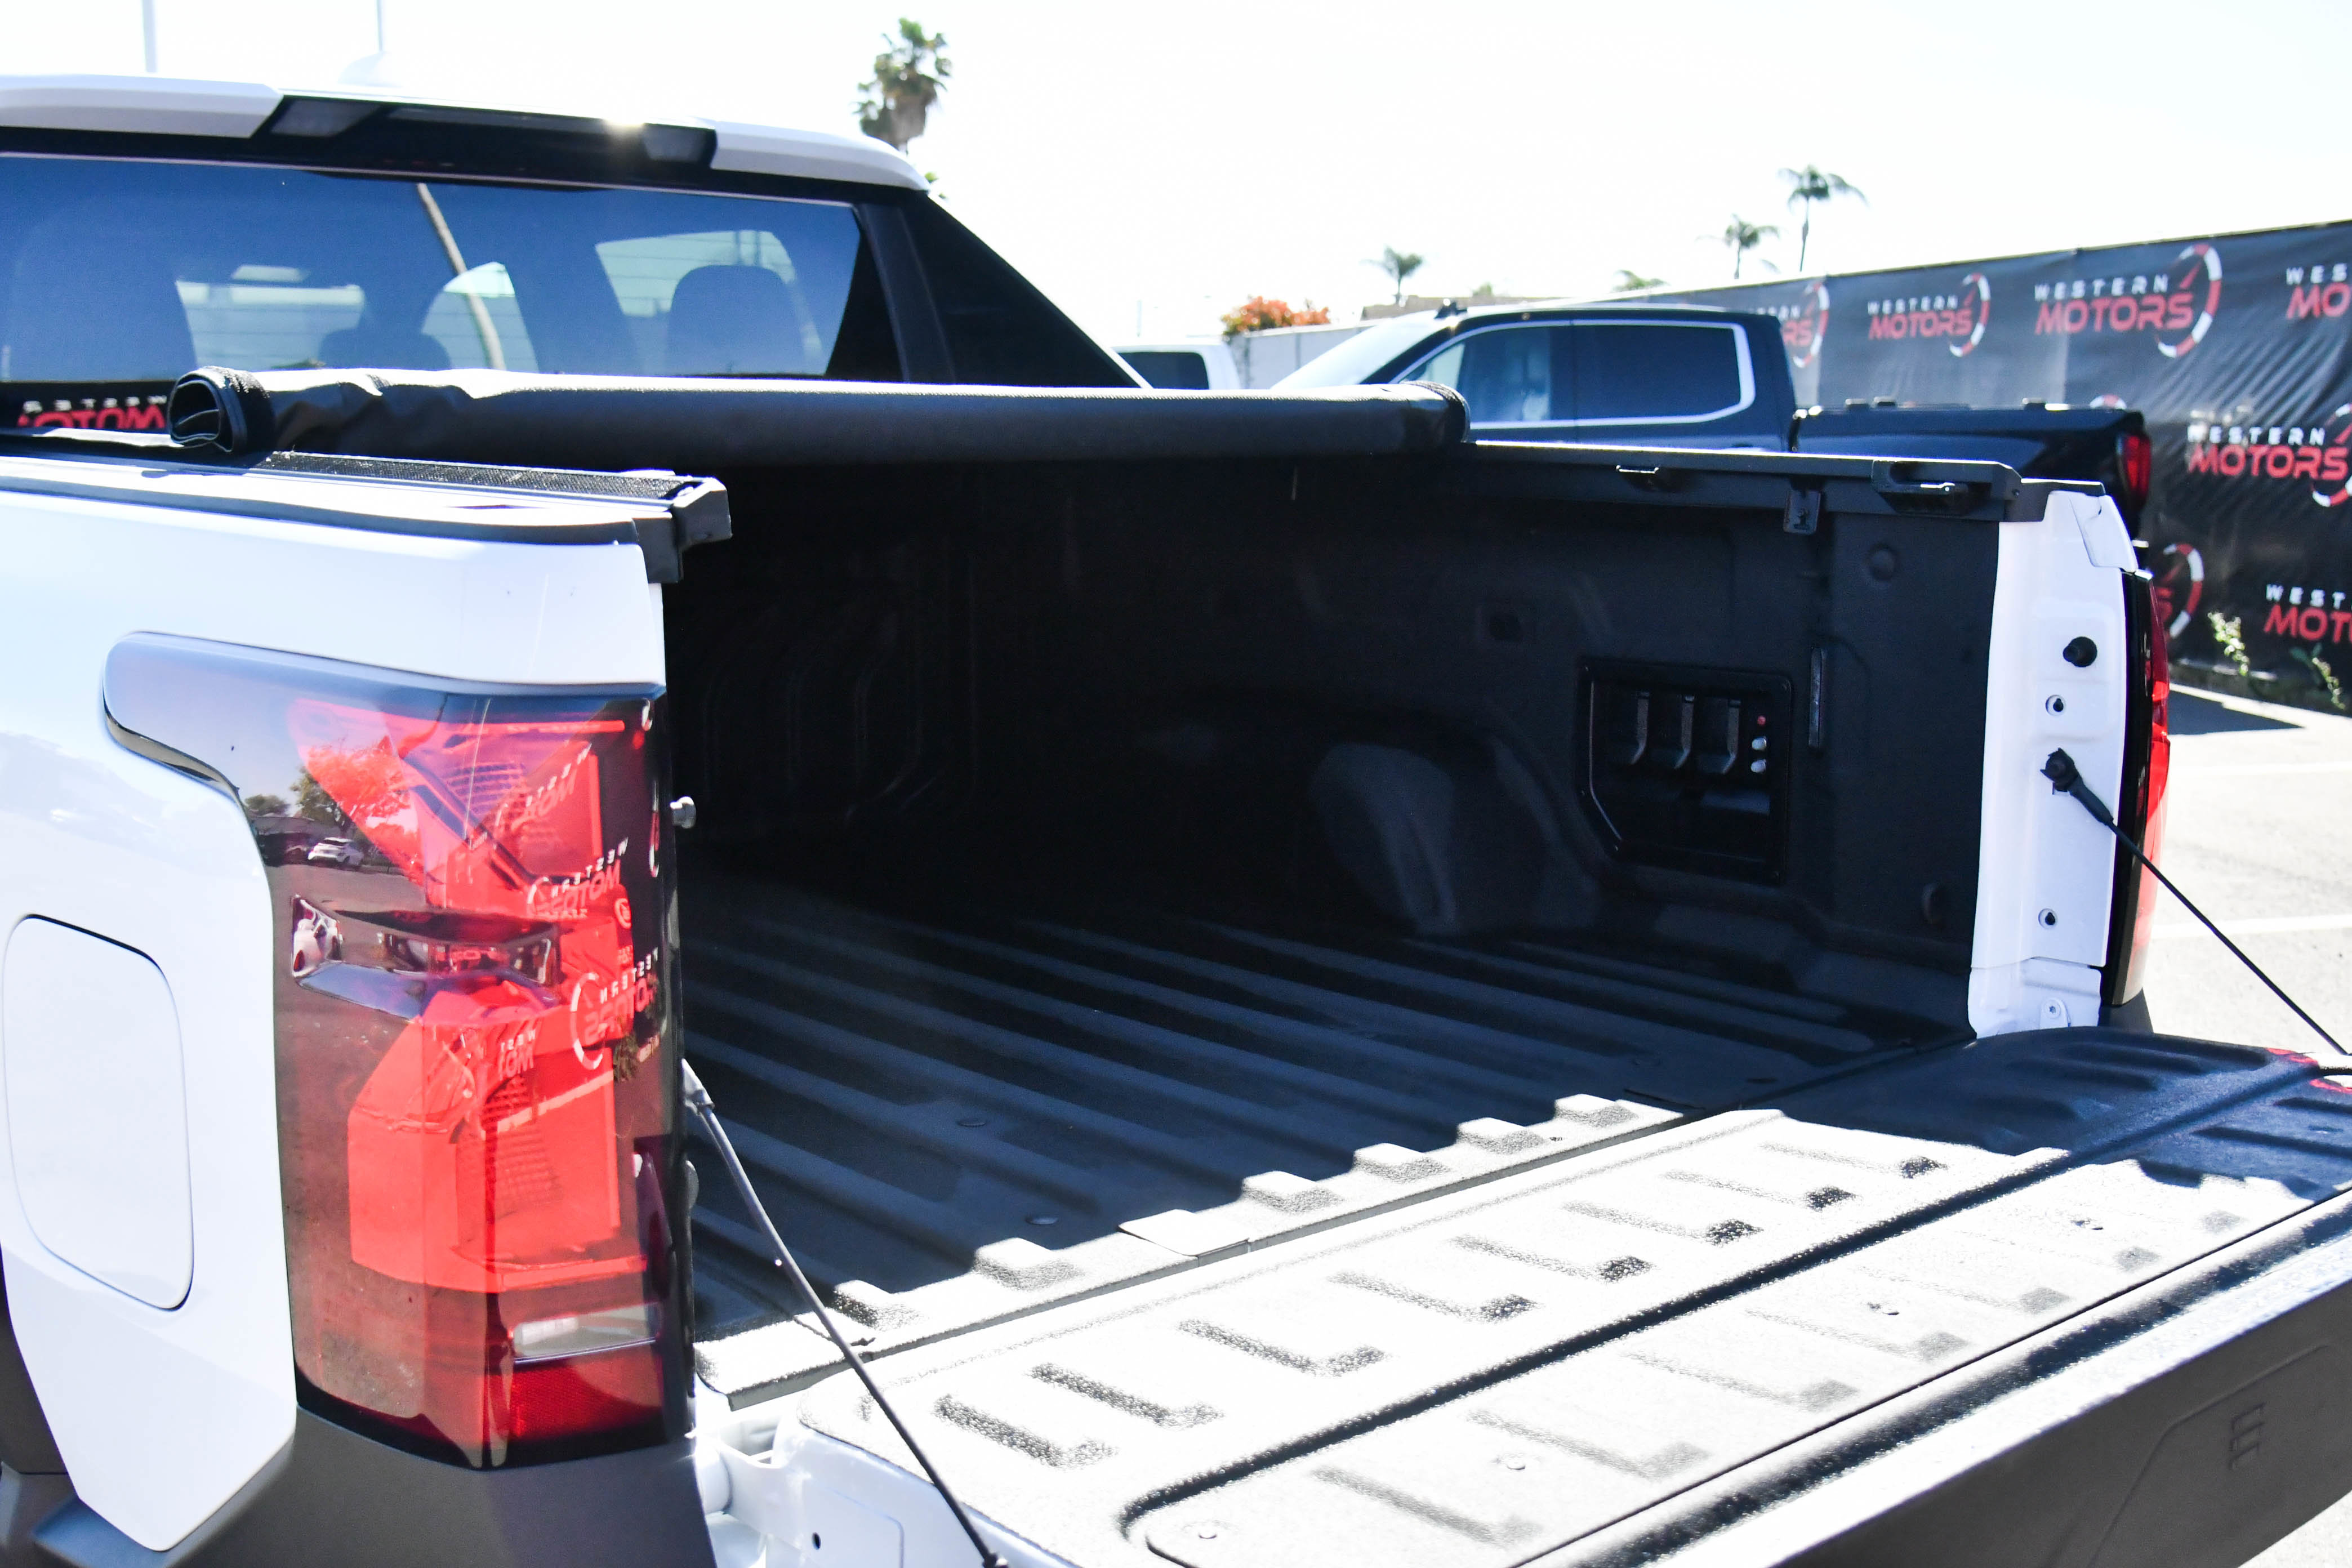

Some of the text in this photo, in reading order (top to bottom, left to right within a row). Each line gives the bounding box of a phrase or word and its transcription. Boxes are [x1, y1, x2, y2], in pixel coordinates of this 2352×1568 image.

[2034, 275, 2169, 300] WESTERN
[1868, 295, 1958, 315] WESTERN
[2035, 292, 2194, 335] MOTORS
[1868, 310, 1972, 340] MOTORS
[2187, 423, 2326, 446] WESTERN
[2188, 444, 2349, 480] MOTORS
[2264, 604, 2352, 644] MOT
